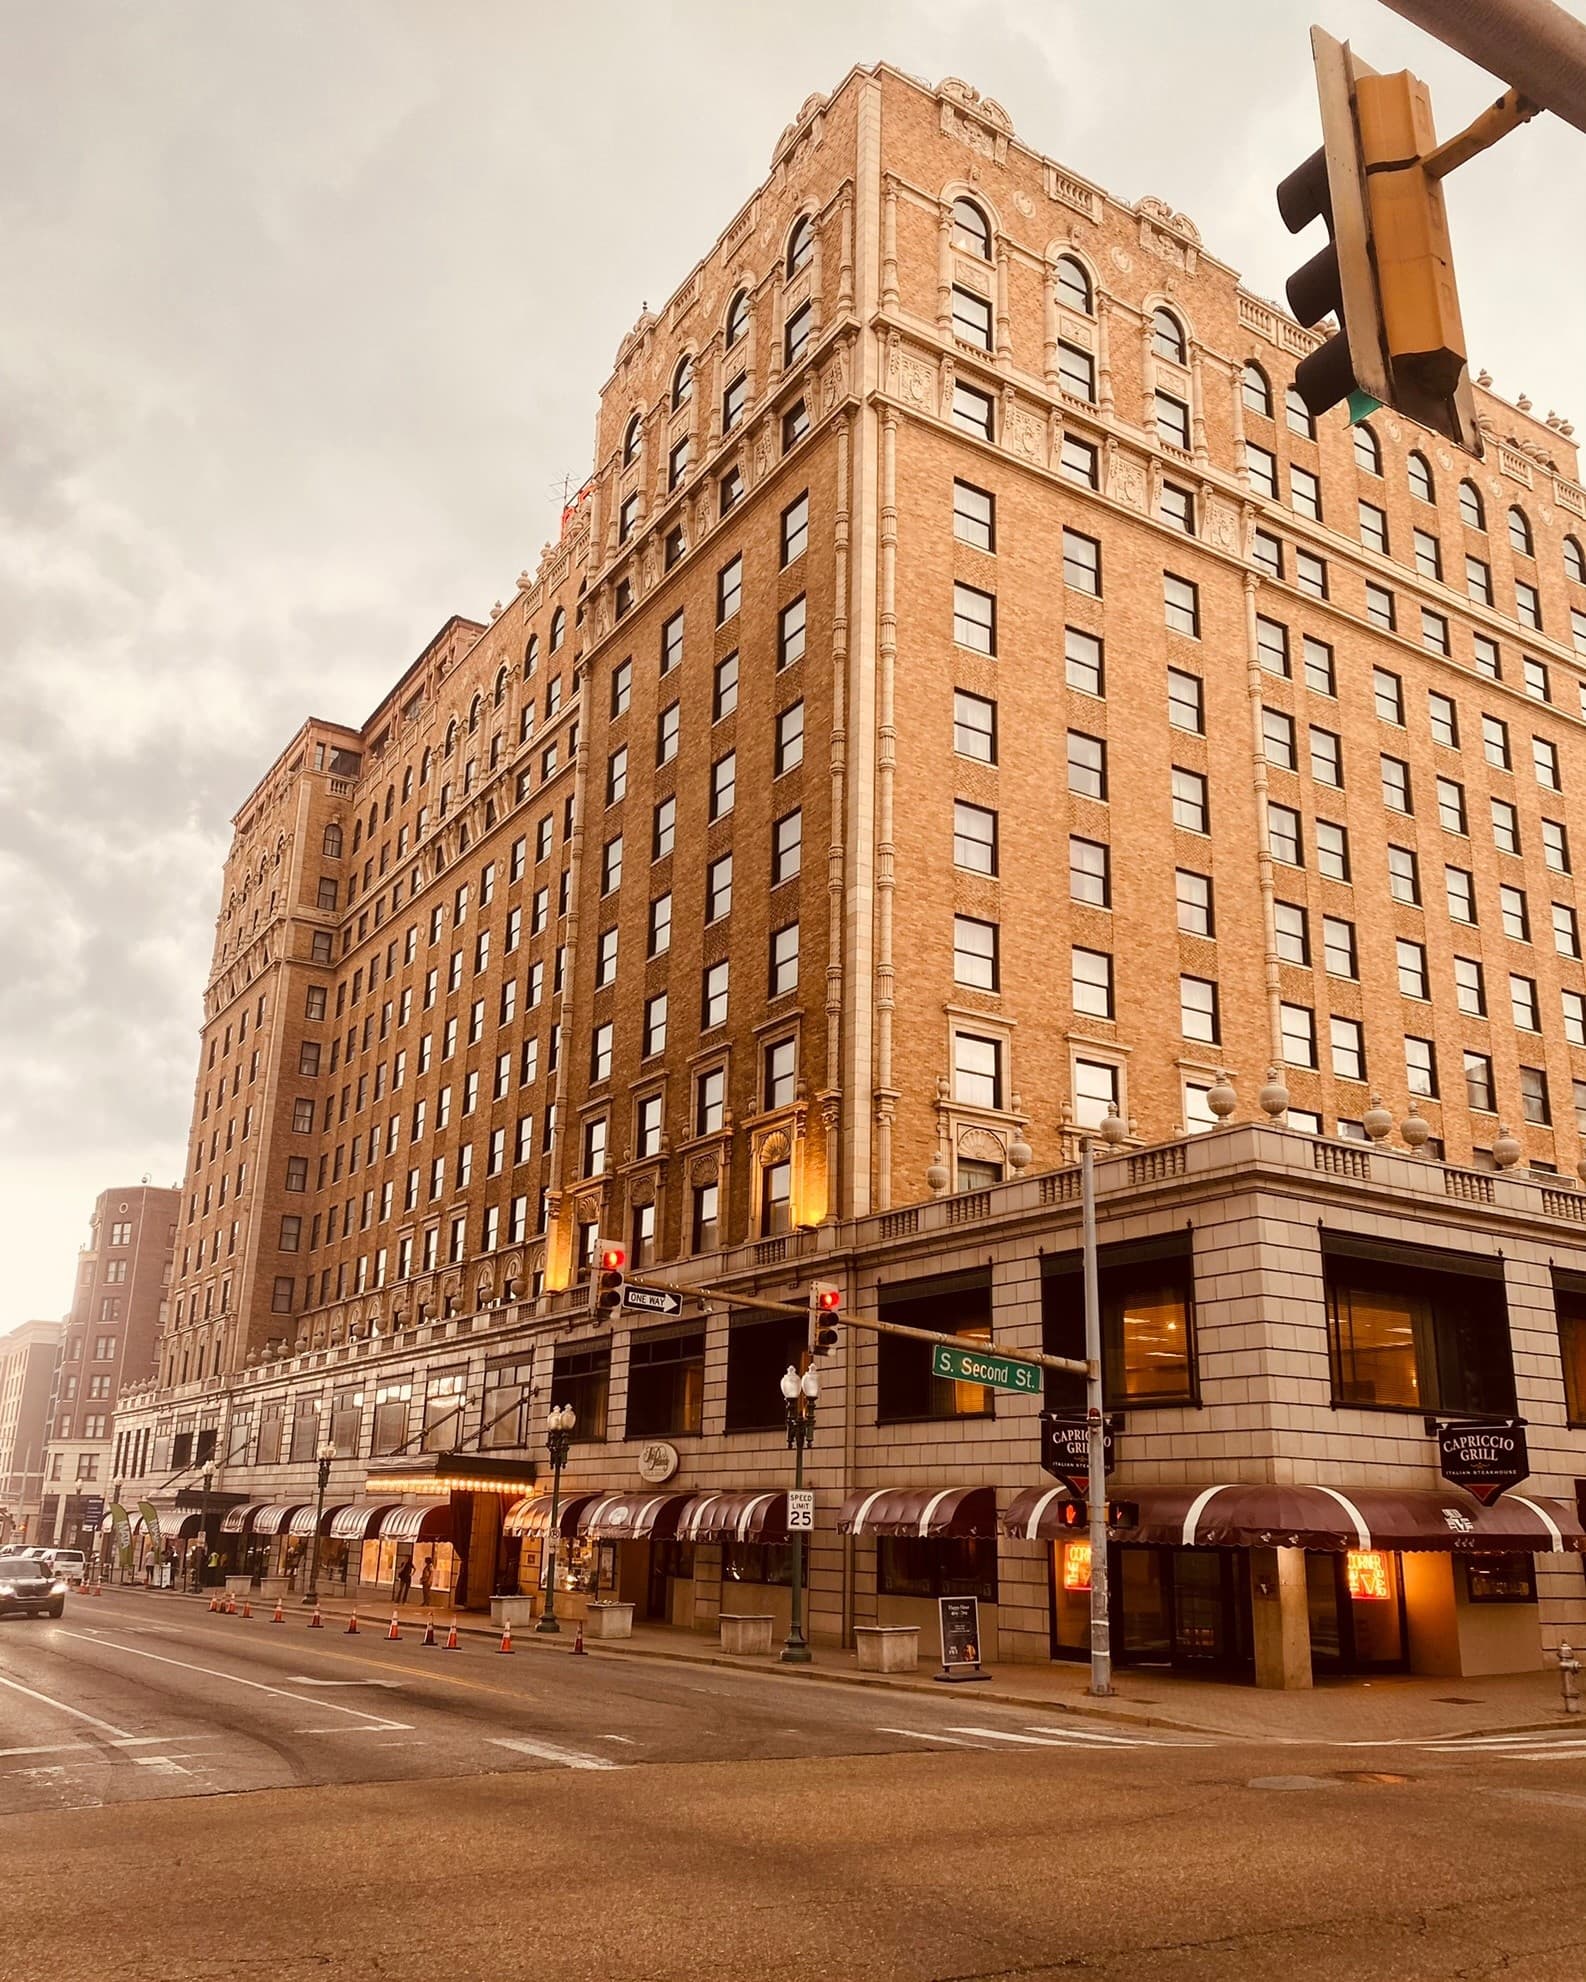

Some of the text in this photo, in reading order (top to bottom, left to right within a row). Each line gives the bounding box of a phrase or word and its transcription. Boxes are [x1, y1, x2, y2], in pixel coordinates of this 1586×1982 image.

[630, 1293, 665, 1306] ONE WAY
[939, 1352, 1035, 1389] S. Second St.
[1443, 1435, 1515, 1453] CAPRICCIO
[1460, 1448, 1499, 1462] GRILL
[790, 1494, 813, 1502] SPEED
[792, 1502, 810, 1510] LIMIT
[790, 1510, 812, 1526] 25
[1347, 1553, 1381, 1570] CORNER
[1374, 1569, 1387, 1597] BAR
